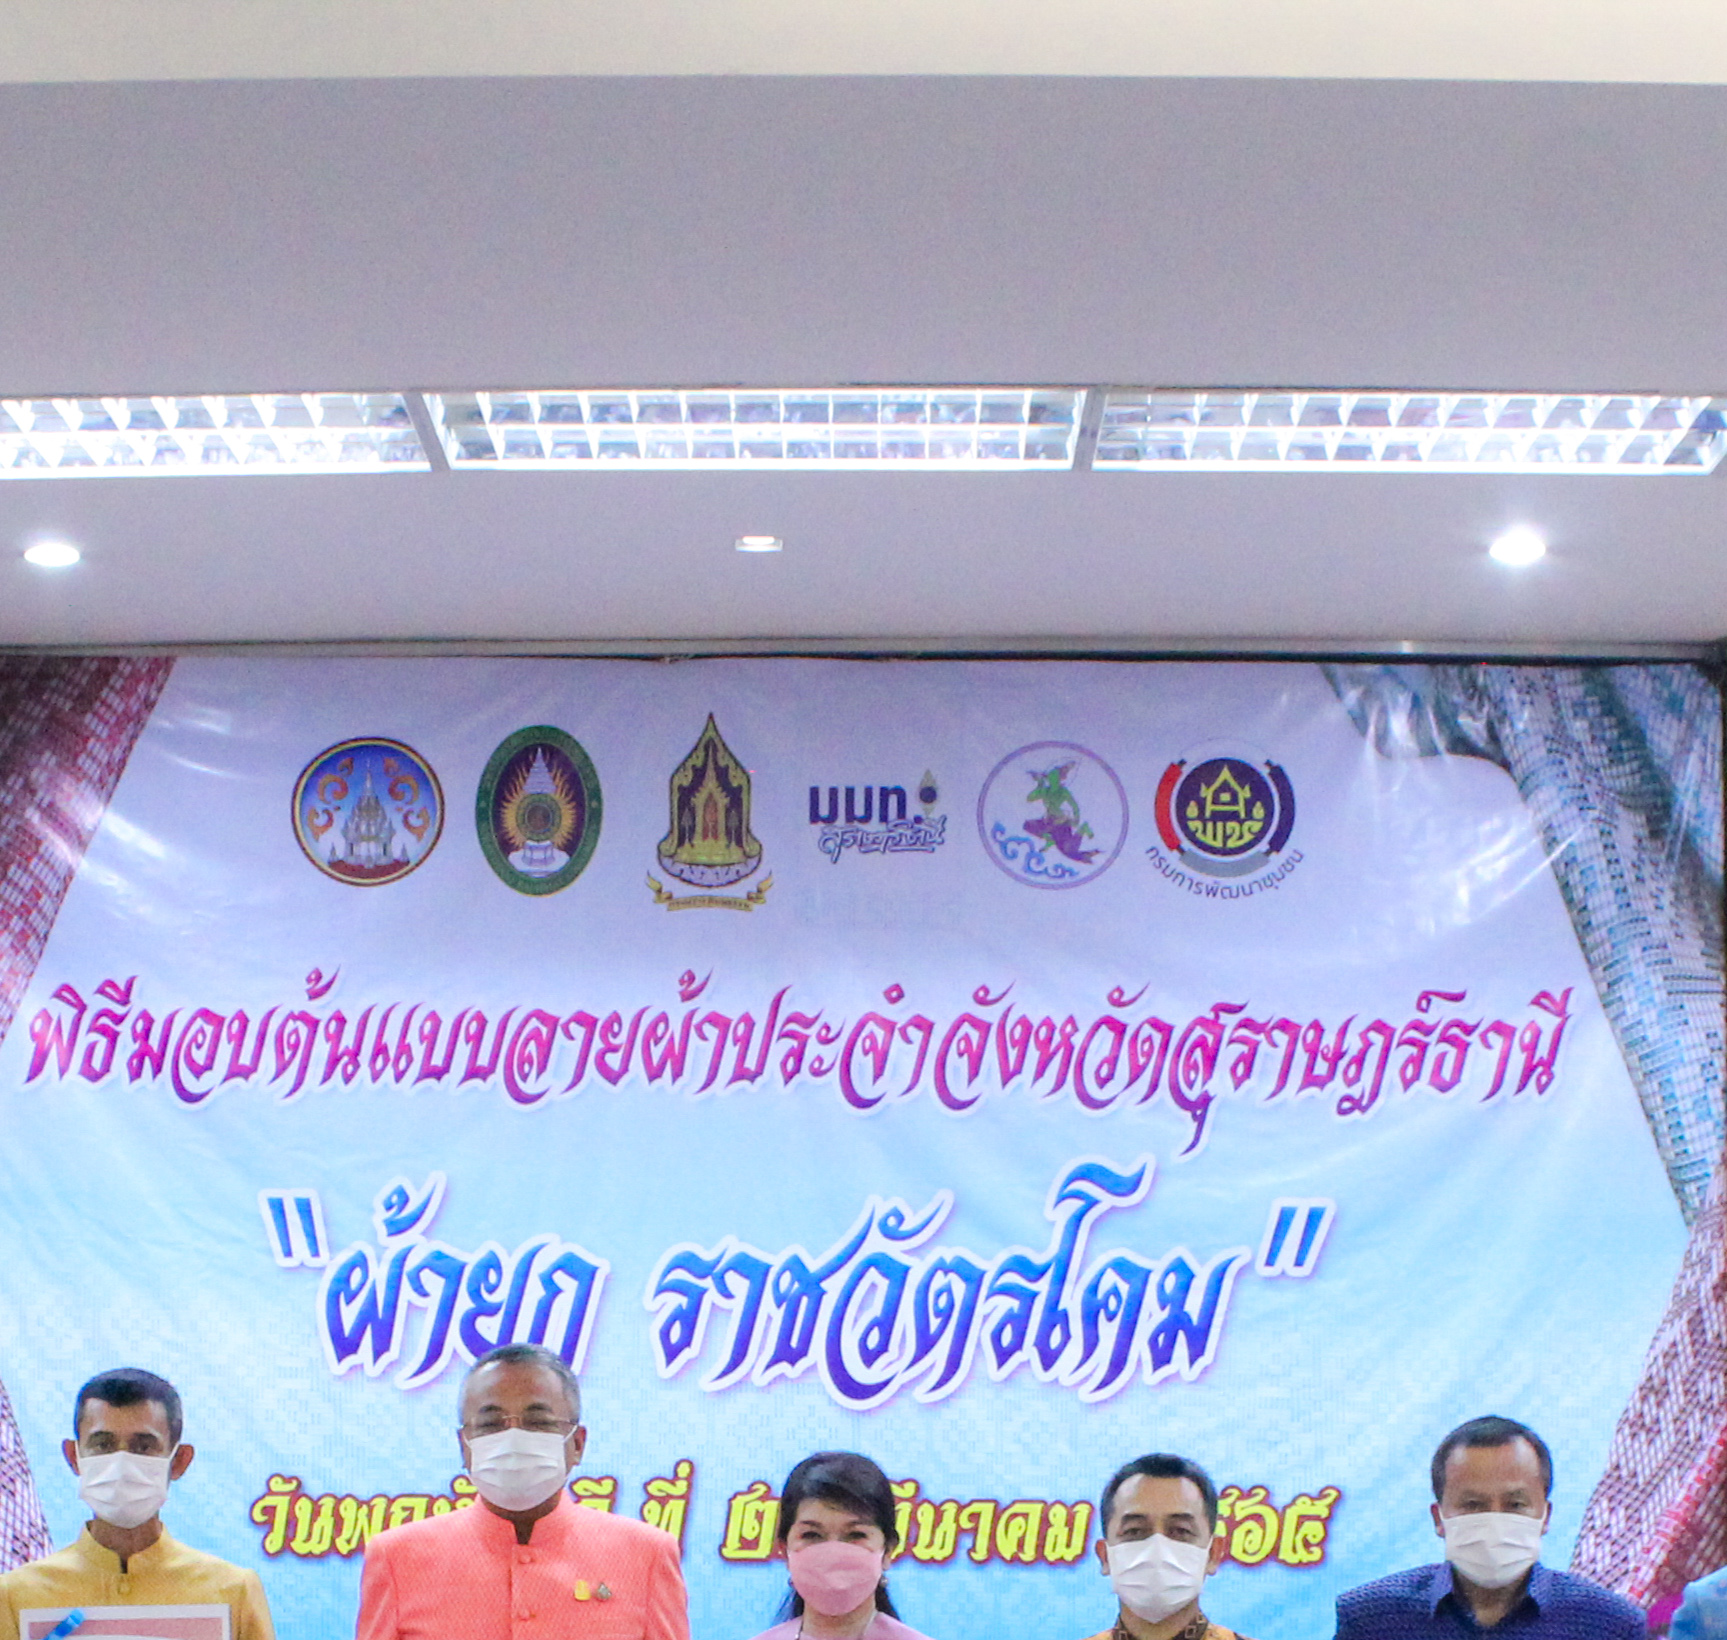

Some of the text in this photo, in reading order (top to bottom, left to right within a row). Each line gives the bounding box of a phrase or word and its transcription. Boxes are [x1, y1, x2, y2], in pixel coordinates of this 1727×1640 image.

[1145, 845, 1305, 899] กรมการพัฒนาชุมชน
[24, 964, 1574, 1157] พิธีมอบต้นแบบลายผ้าประจำจังหวัดสุราษฎร์ธานี
